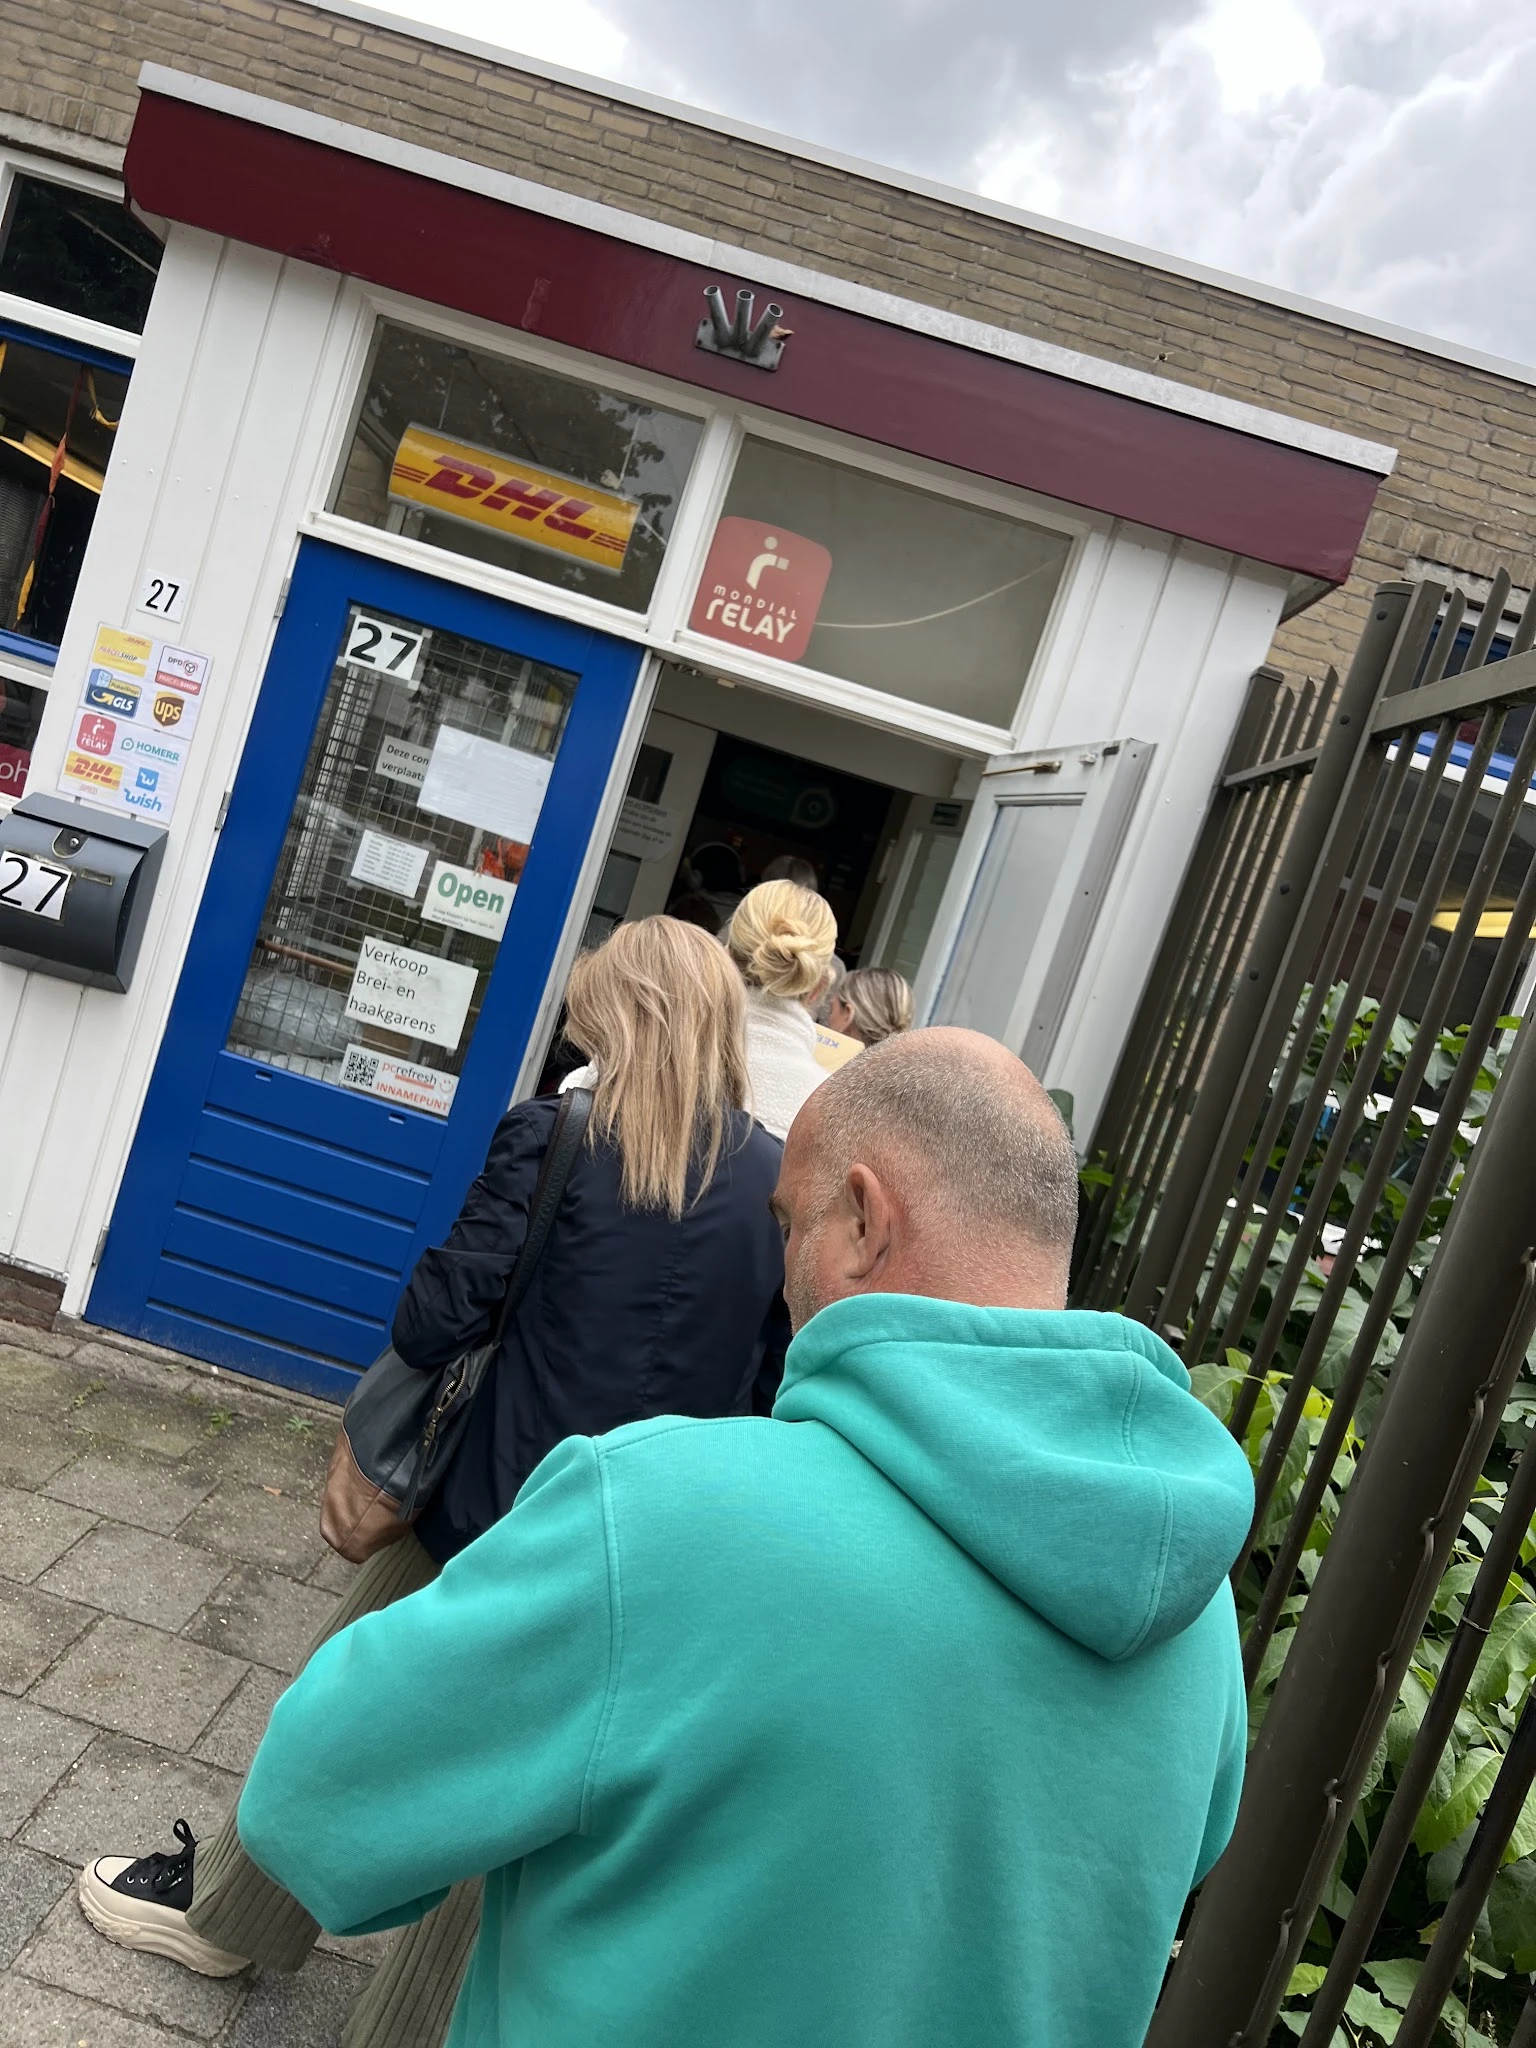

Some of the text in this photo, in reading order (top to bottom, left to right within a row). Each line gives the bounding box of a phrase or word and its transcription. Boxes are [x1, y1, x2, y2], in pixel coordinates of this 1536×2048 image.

[425, 455, 597, 540] DHL
[145, 578, 180, 613] 27
[167, 656, 183, 666] DPD
[349, 621, 418, 672] 27
[112, 697, 134, 711] GLS
[155, 699, 182, 722] ups
[136, 742, 180, 762] HOMERR
[386, 744, 410, 759] Deze
[72, 757, 114, 784] DHL
[123, 788, 162, 812] wish
[0, 857, 69, 913] 27
[437, 872, 505, 914] Open
[364, 943, 429, 977] Verkoop
[356, 970, 416, 1000] Brei- en
[349, 995, 437, 1035] haakgarens
[376, 1080, 449, 1112] INNAMEPUNT
